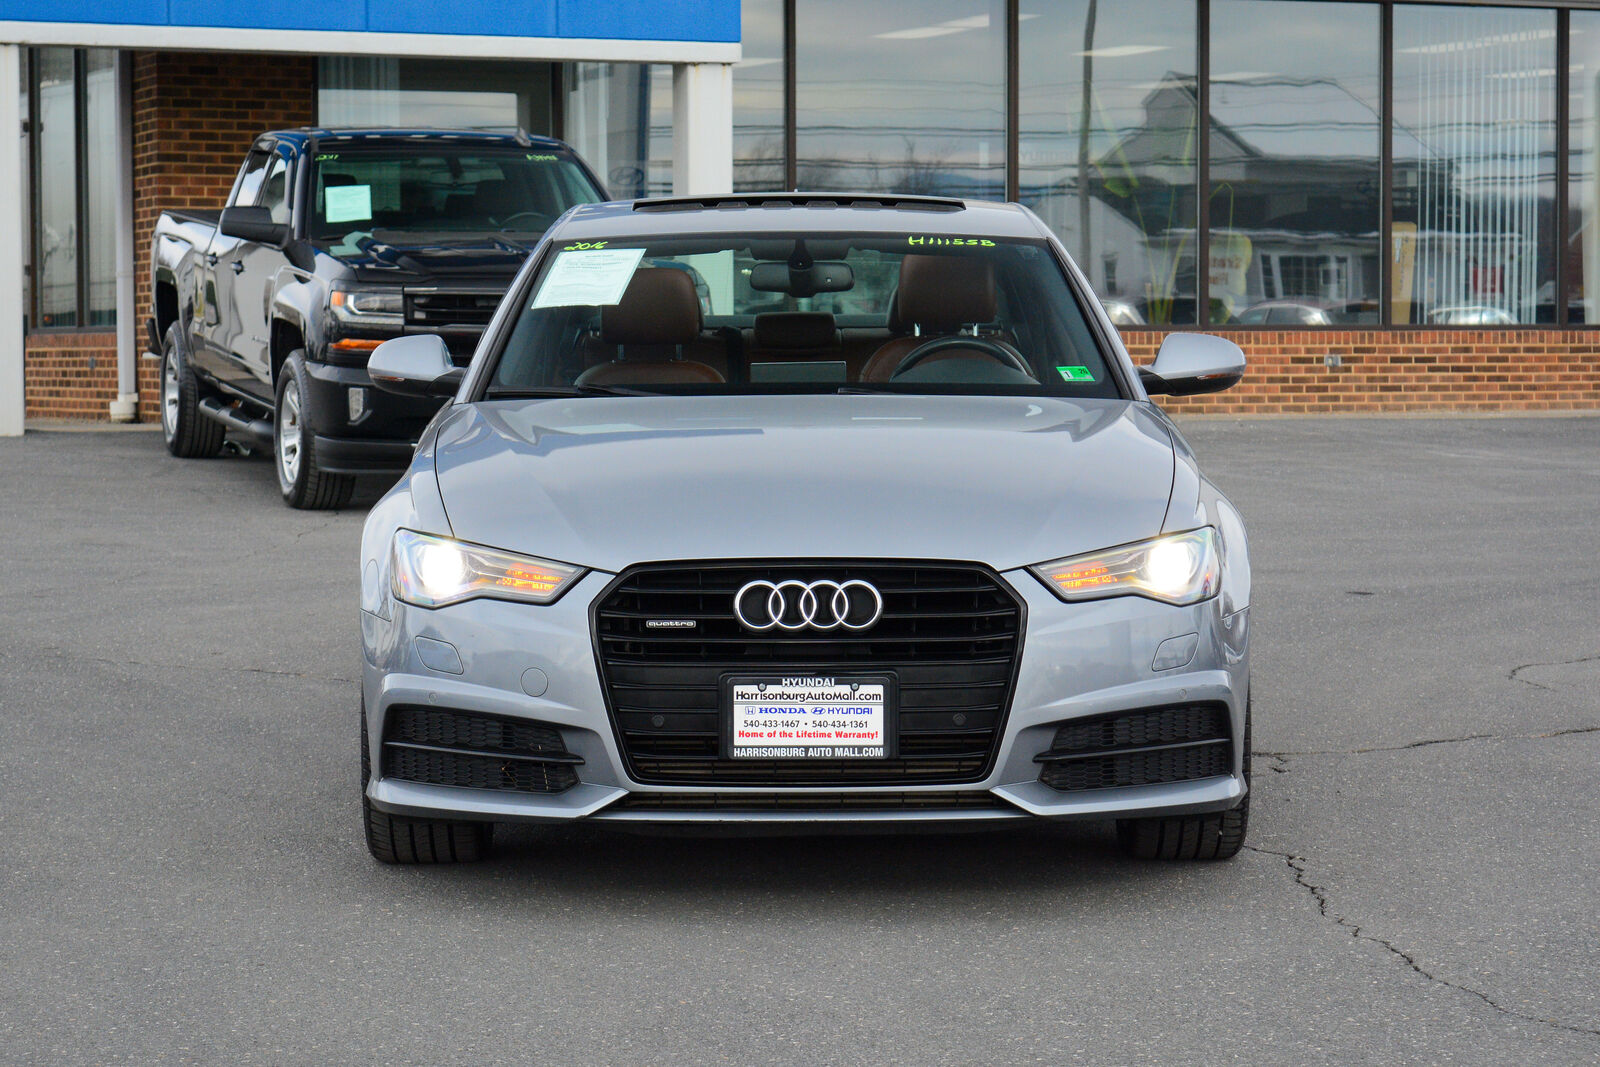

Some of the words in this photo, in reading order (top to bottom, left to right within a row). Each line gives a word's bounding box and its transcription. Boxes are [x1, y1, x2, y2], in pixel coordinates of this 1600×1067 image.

[563, 241, 609, 251] 2016
[782, 678, 835, 687] HYUNDAI
[736, 691, 881, 702] HarrisonburgAutoMall.com
[812, 720, 868, 728] 540-434-1361
[835, 731, 878, 739] Warranty!
[734, 748, 805, 756] HARRISONBURG
[808, 748, 831, 756] AUTO
[835, 748, 883, 756] MALL.COM
